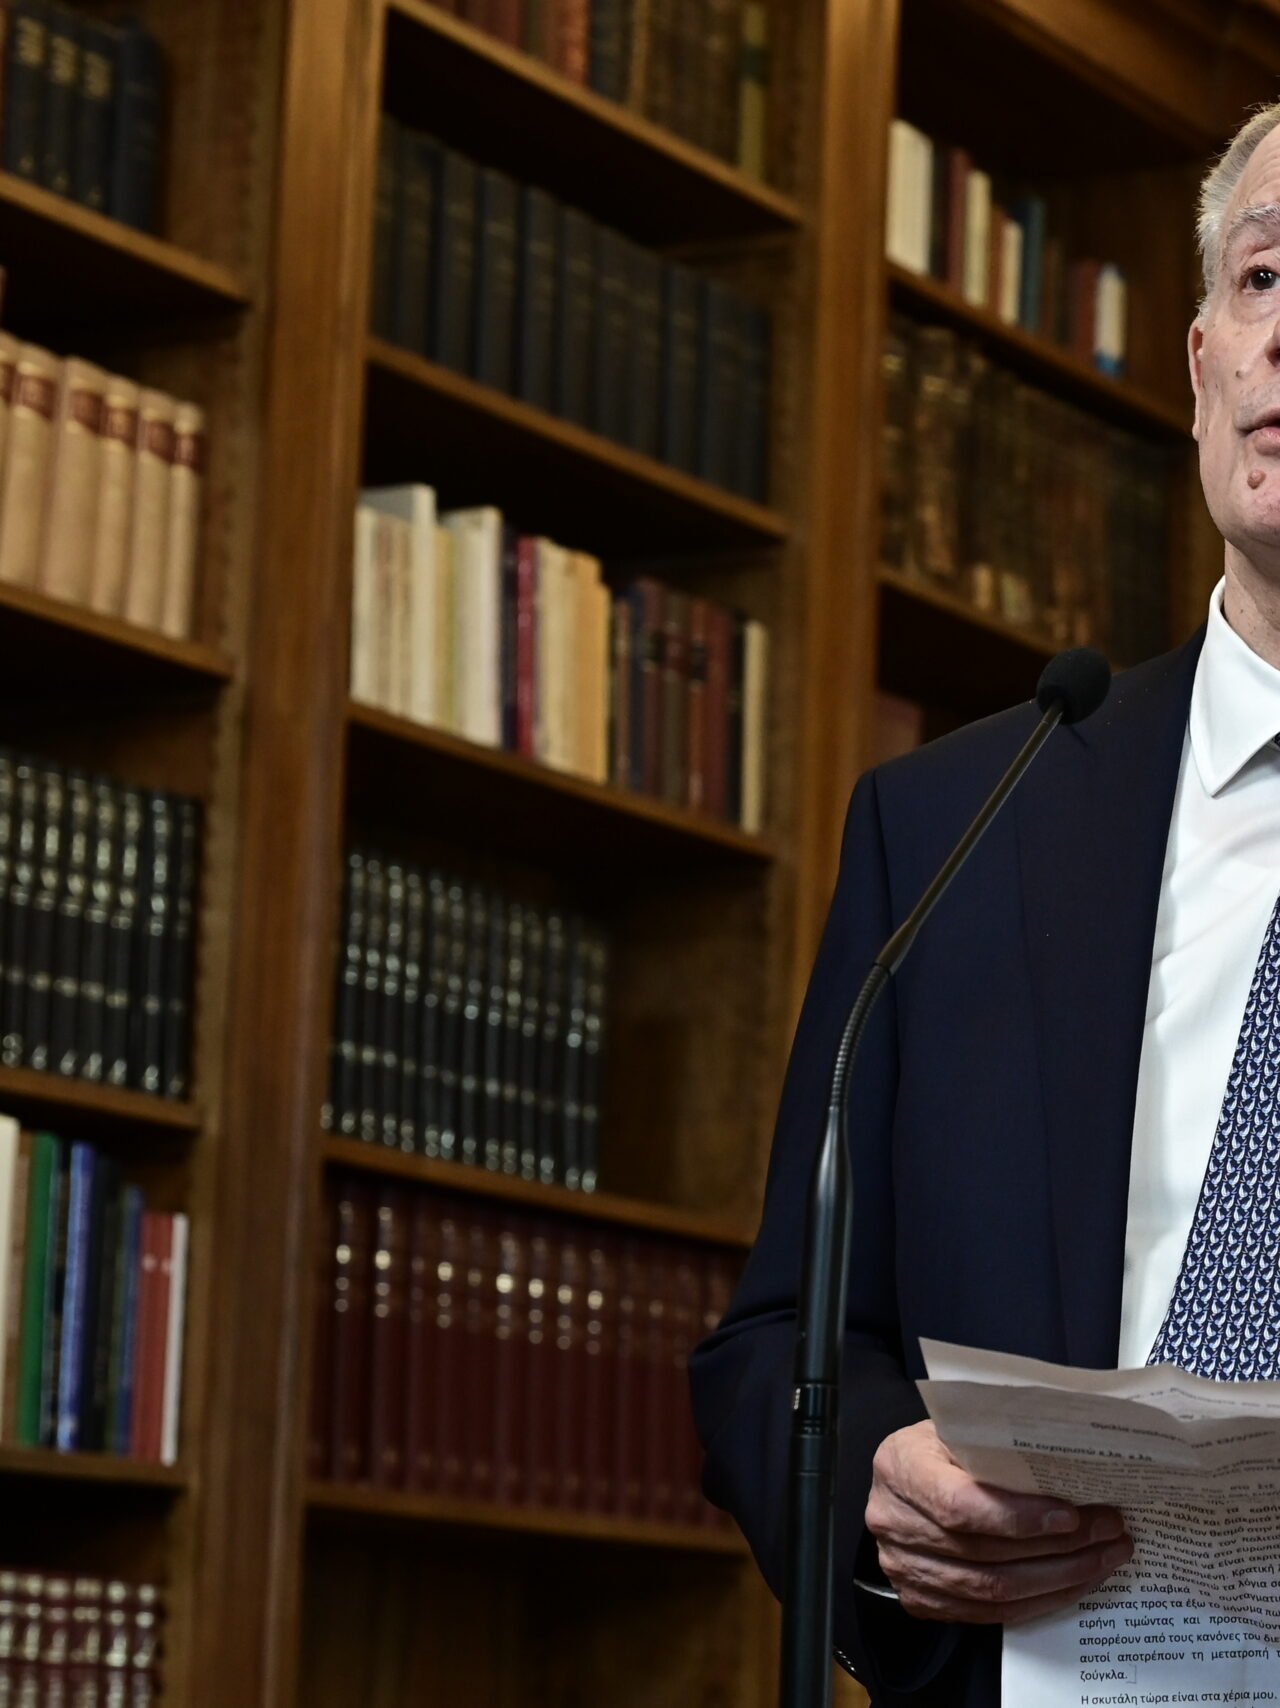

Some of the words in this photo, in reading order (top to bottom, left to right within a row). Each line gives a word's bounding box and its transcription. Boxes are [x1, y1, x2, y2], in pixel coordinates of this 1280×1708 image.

[1174, 1513, 1200, 1525] αλλά
[1142, 1516, 1186, 1533] Ανοίξατε
[1189, 1528, 1207, 1536] τον
[1209, 1526, 1245, 1538] θεσμό
[1155, 1530, 1213, 1548] Προβάλατε
[1218, 1539, 1237, 1547] τον
[1139, 1548, 1159, 1556] που
[1163, 1554, 1198, 1567] μπορεί
[1218, 1557, 1245, 1568] είναι
[1174, 1546, 1210, 1560] ενεργά
[1213, 1549, 1233, 1558] στο
[1143, 1559, 1168, 1569] ποτέ
[1135, 1571, 1151, 1579] για
[1238, 1577, 1267, 1588] λόγια
[1140, 1583, 1191, 1595] ευλαβικά
[1078, 1599, 1138, 1611] περνώντας
[1141, 1600, 1168, 1611] προς
[1170, 1600, 1183, 1608] τα
[1185, 1598, 1206, 1609] έξω
[1208, 1601, 1221, 1609] το
[1223, 1605, 1262, 1615] μήνυμα
[1079, 1616, 1116, 1628] ειρήνη
[1124, 1616, 1175, 1628] τιμώντας
[1183, 1616, 1200, 1625] και
[1079, 1635, 1141, 1647] απορρέουν
[1144, 1633, 1166, 1645] από
[1168, 1635, 1194, 1644] τους
[1197, 1630, 1241, 1641] κανόνες
[1243, 1632, 1261, 1641] του
[1080, 1652, 1111, 1663] αυτοί
[1117, 1651, 1185, 1664] αποτρέπουν
[1192, 1651, 1204, 1661] τη
[1211, 1649, 1270, 1661] μετατροπή
[1080, 1669, 1128, 1683] ζούγκλα.
[1081, 1695, 1089, 1704] Η
[1092, 1693, 1138, 1706] σκυτάλη
[1140, 1692, 1169, 1704] τώρα
[1171, 1691, 1198, 1702] είναι
[1201, 1693, 1220, 1701] στα
[1222, 1690, 1250, 1703] χέρια
[1253, 1692, 1277, 1702] μου.
